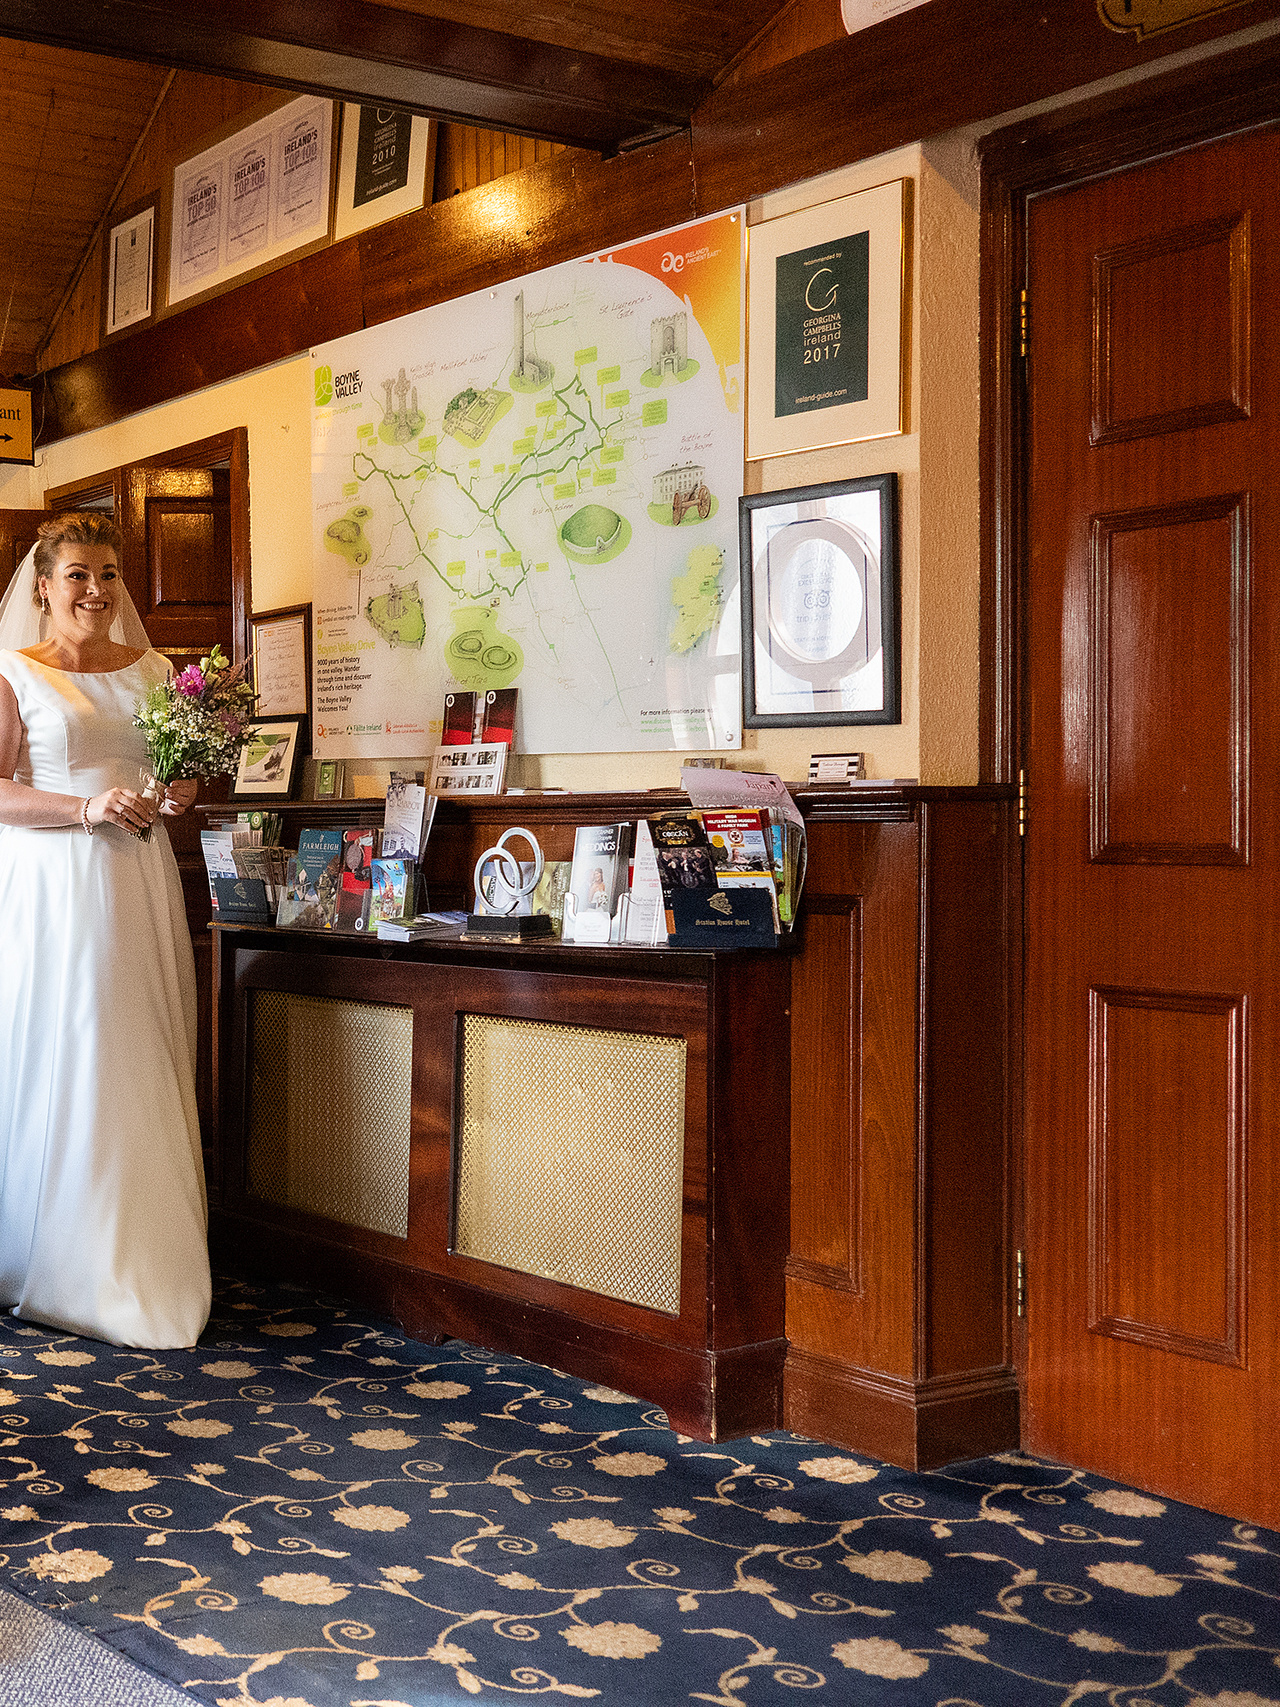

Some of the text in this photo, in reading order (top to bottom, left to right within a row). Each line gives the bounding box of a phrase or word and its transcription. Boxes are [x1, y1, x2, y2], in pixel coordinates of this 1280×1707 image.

[284, 129, 318, 156] IRELAND'S
[372, 145, 396, 165] 2010
[234, 157, 266, 183] IRELAND'S
[803, 312, 841, 328] GEORGINA
[803, 321, 841, 337] CAMPBELL'S
[803, 330, 841, 347] ireland
[803, 343, 841, 365] 2017
[334, 369, 361, 388] BOYNE
[334, 380, 364, 400] VALLEY
[795, 387, 848, 404] ireland-guide.com
[327, 659, 339, 667] years
[340, 656, 345, 664] of
[344, 656, 360, 664] history
[744, 779, 774, 791] Japan
[302, 842, 339, 851] FARMLEIGH
[582, 841, 616, 852] EDDINGS
